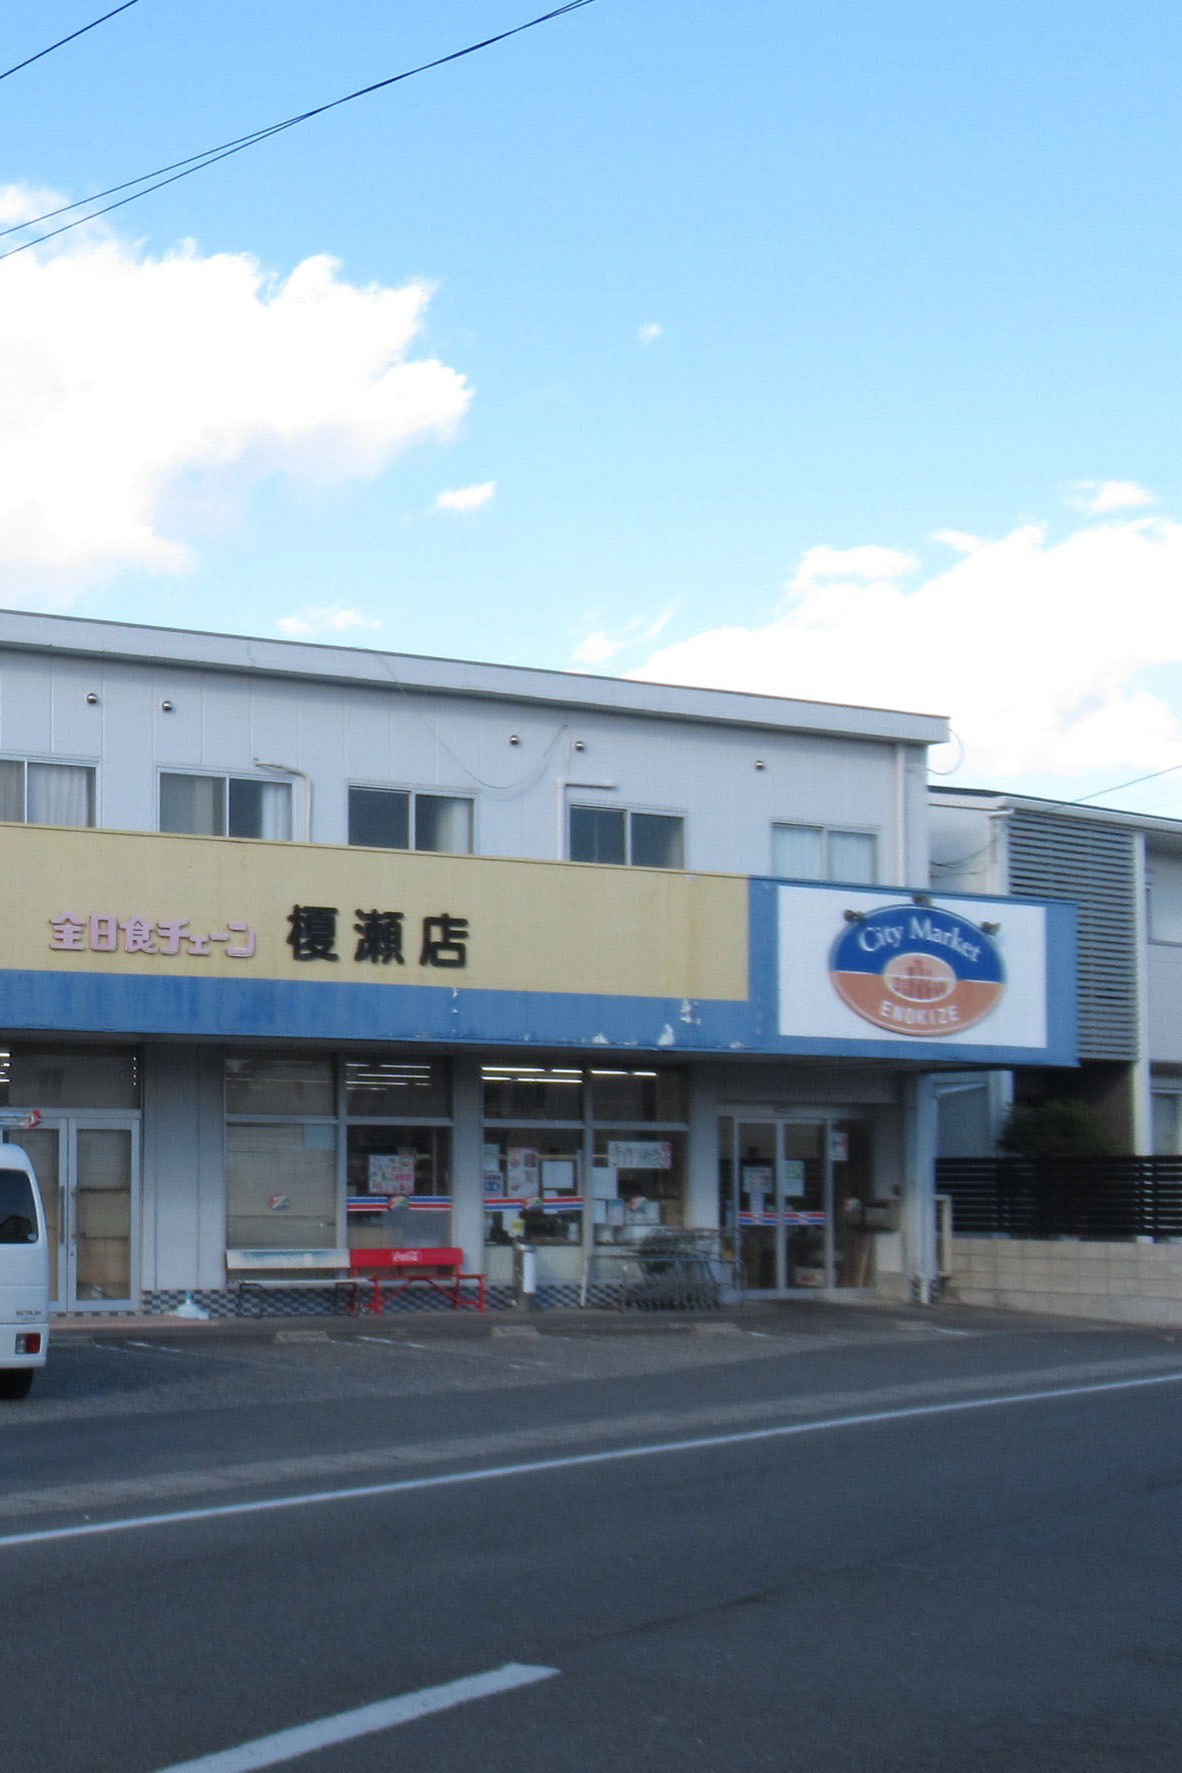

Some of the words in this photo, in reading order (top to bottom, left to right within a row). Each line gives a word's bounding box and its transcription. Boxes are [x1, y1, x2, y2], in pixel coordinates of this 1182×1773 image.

[49, 911, 256, 958] 全日食チェーン
[285, 904, 470, 969] 榎瀬店
[859, 925, 904, 952] City
[909, 916, 981, 962] Market
[881, 1000, 959, 1024] ENOKIZE
